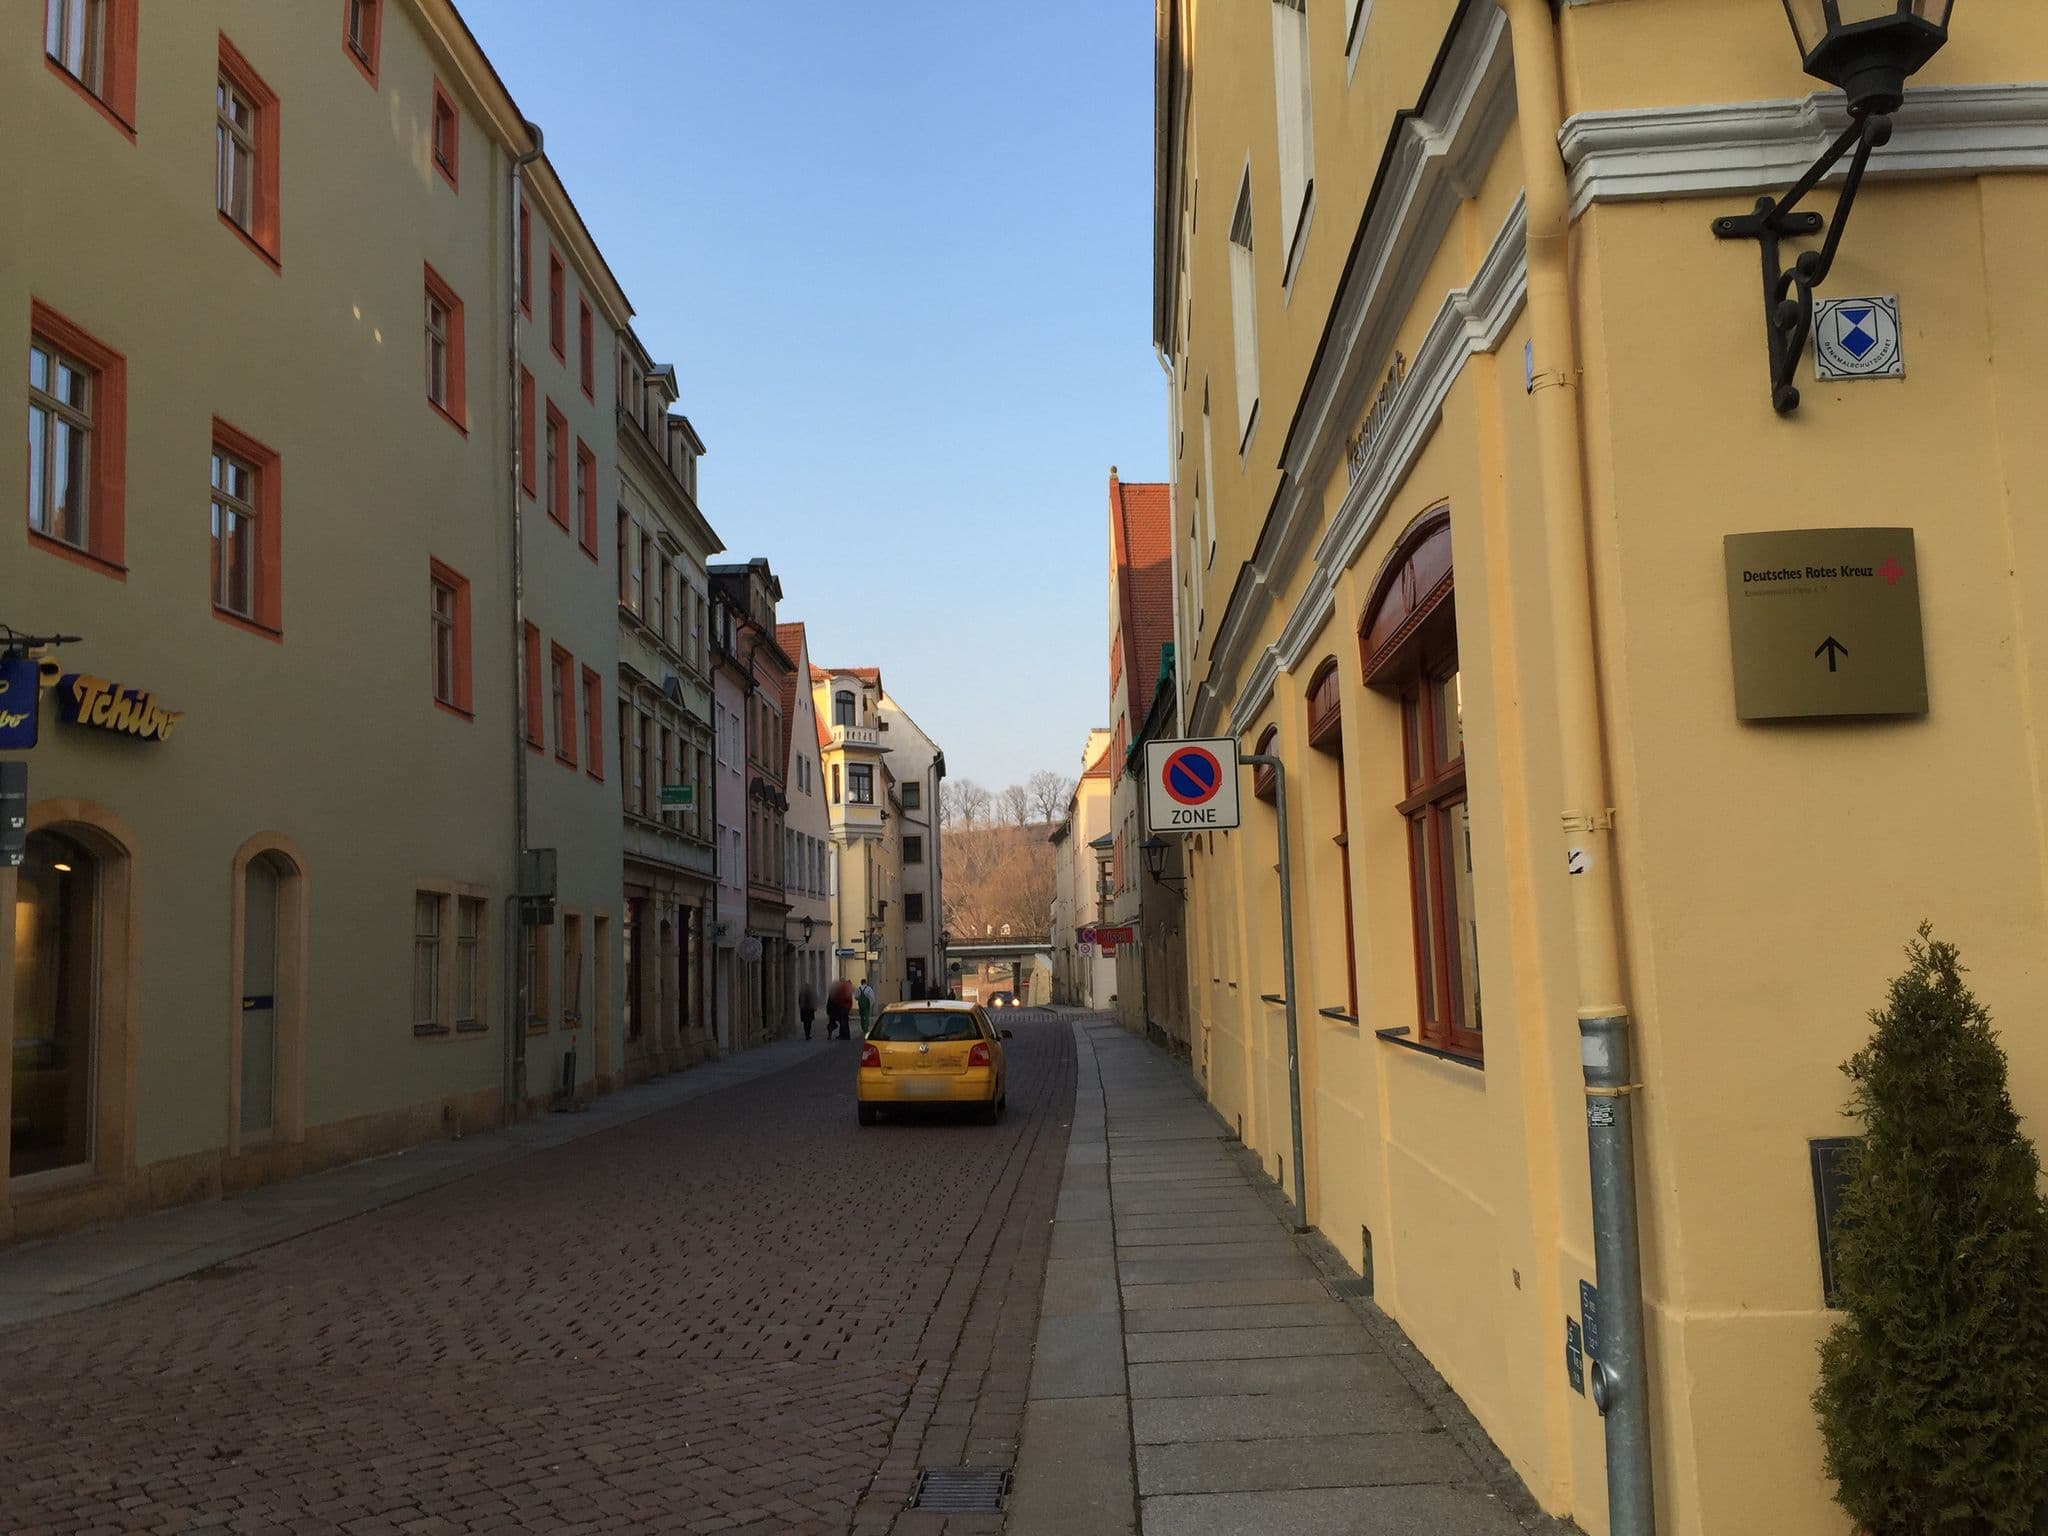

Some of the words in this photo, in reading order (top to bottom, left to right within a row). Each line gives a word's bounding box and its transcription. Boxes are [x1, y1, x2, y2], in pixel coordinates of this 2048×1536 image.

[1743, 568, 1802, 582] Deutsches
[1805, 566, 1837, 578] Rotes
[1840, 565, 1873, 577] Kreuz
[73, 673, 185, 741] Tchibo
[1171, 808, 1217, 825] ZONE
